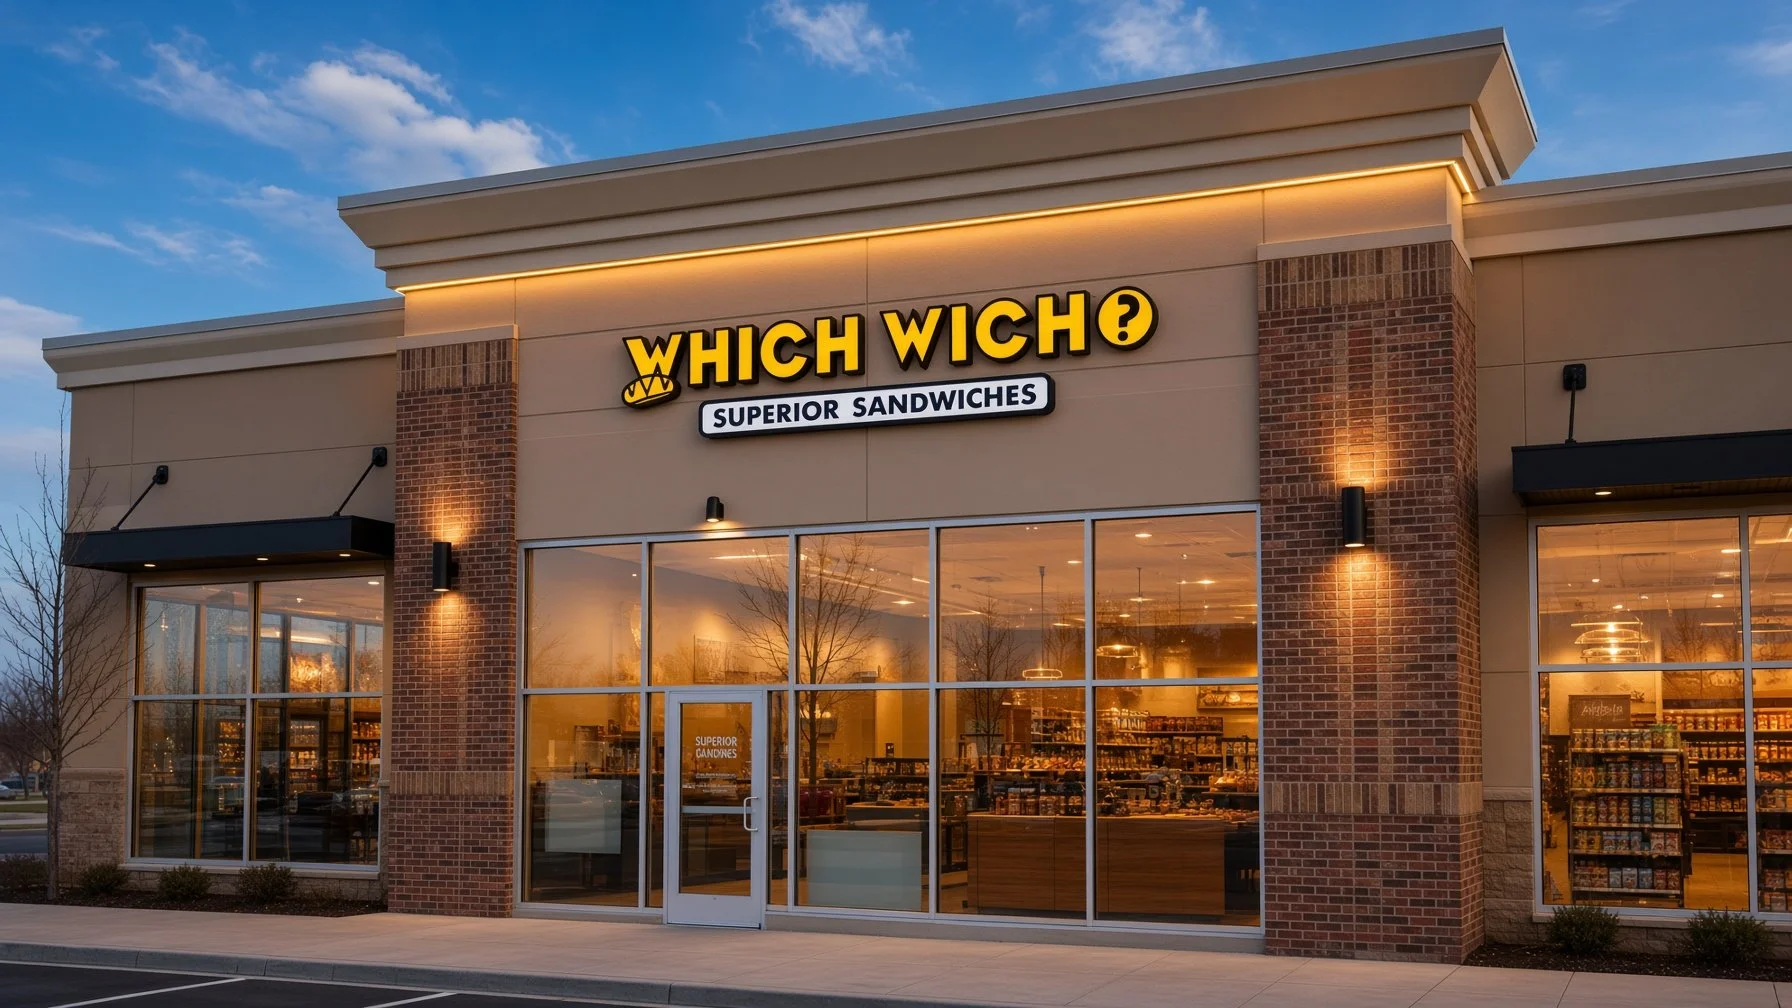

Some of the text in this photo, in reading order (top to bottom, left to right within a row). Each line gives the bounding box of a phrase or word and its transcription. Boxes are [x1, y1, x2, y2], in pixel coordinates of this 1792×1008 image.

[622, 313, 865, 396] WHICH
[713, 383, 1037, 428] SUPERIOR SANDWICHES
[695, 736, 737, 747] SUPERIOR
